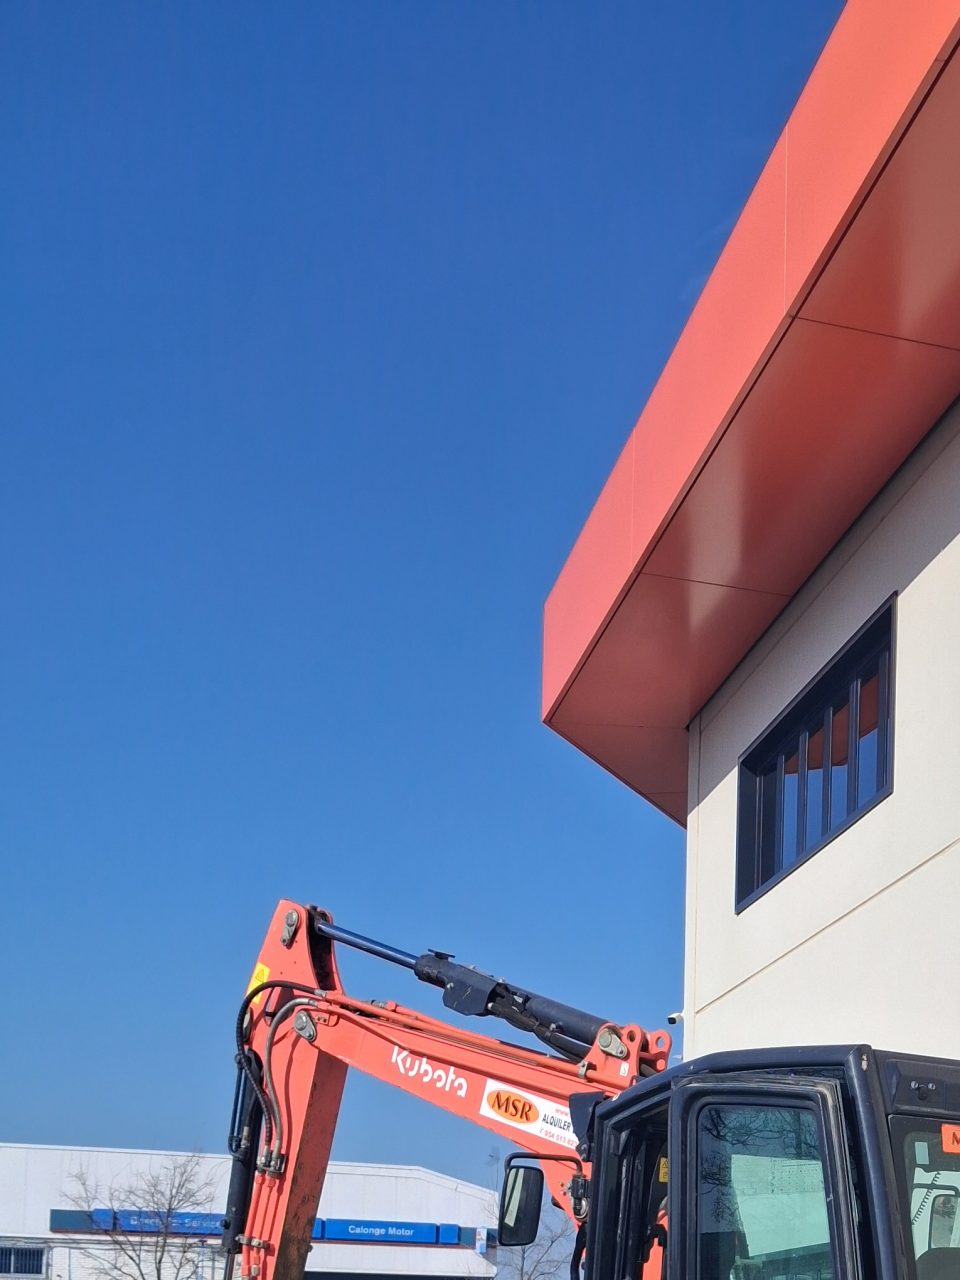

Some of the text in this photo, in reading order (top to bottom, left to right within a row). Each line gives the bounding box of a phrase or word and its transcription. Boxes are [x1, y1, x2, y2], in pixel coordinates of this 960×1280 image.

[391, 1046, 468, 1097] Kubota
[492, 1091, 532, 1122] MSR
[542, 1114, 571, 1132] ALQUILER
[348, 1225, 414, 1236] Calonge Motor
